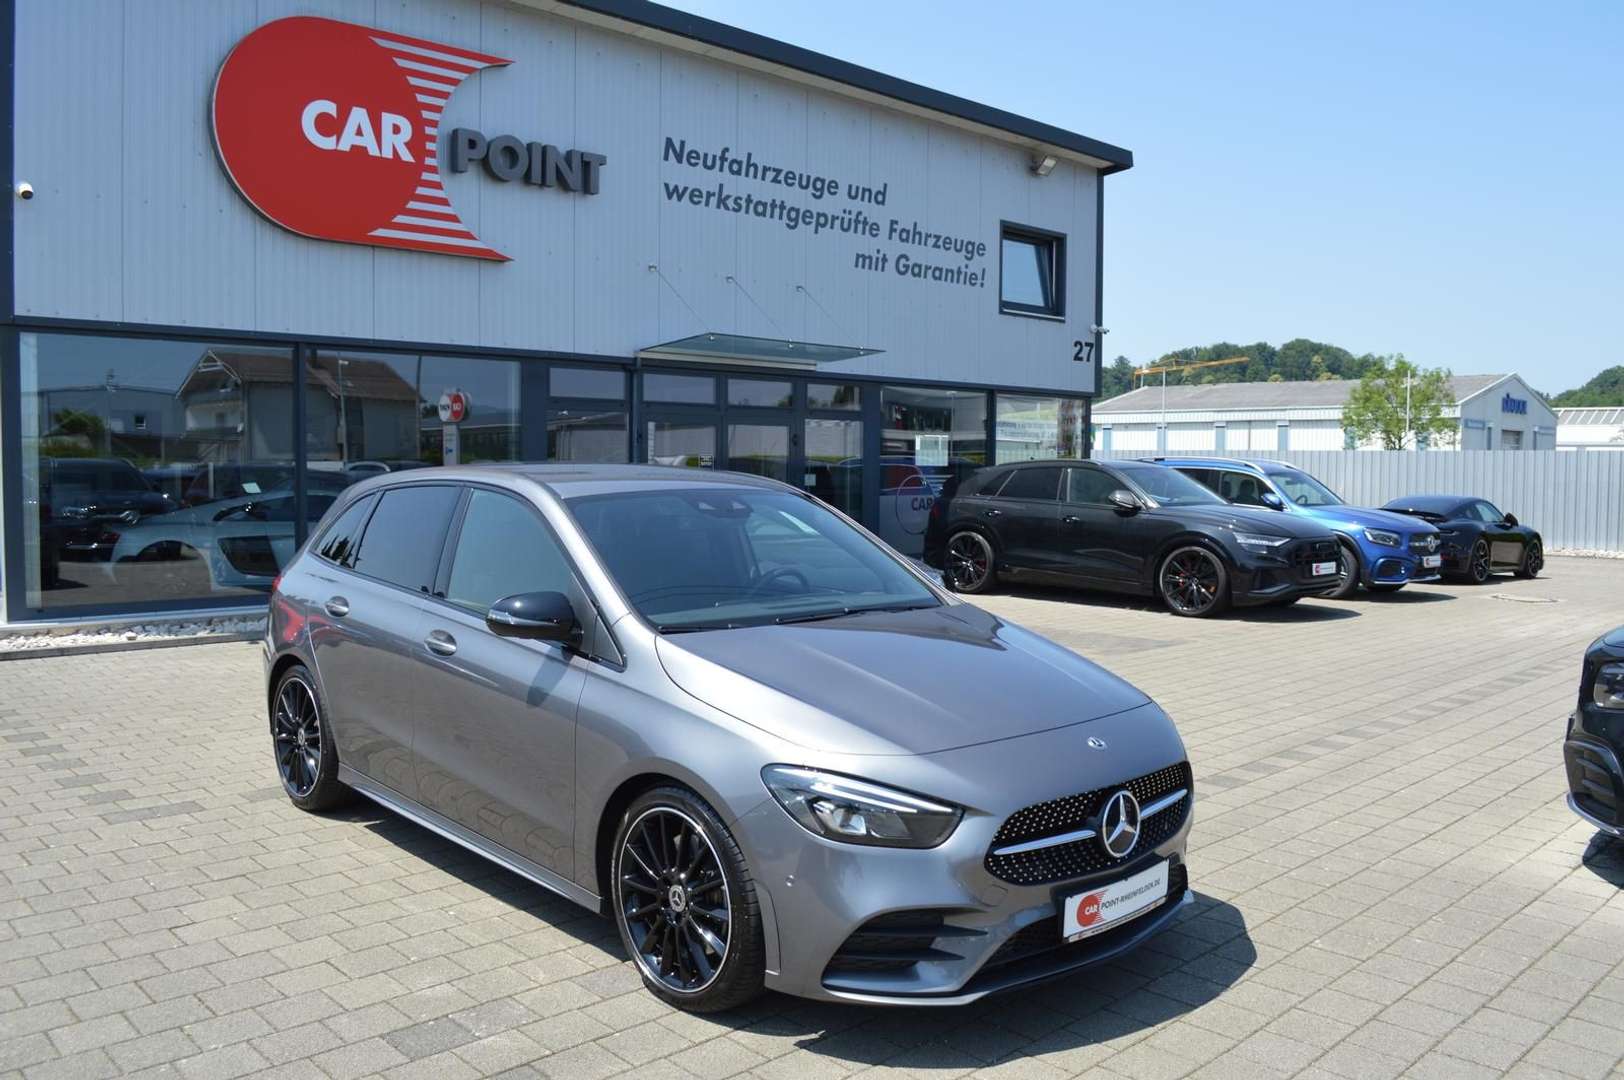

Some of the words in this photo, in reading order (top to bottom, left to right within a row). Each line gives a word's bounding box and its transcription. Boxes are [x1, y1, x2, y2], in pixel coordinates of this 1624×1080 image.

[301, 99, 415, 163] CAR
[451, 127, 606, 195] POINT
[663, 137, 839, 200] Neufahrzeuge
[847, 183, 888, 206] und
[663, 182, 880, 237] werkstattgeprüfte
[888, 219, 986, 261] Fahrzeuge
[854, 249, 889, 272] mit
[895, 253, 986, 288] Garantie!
[1073, 340, 1094, 362] 27
[1084, 904, 1098, 915] CAR
